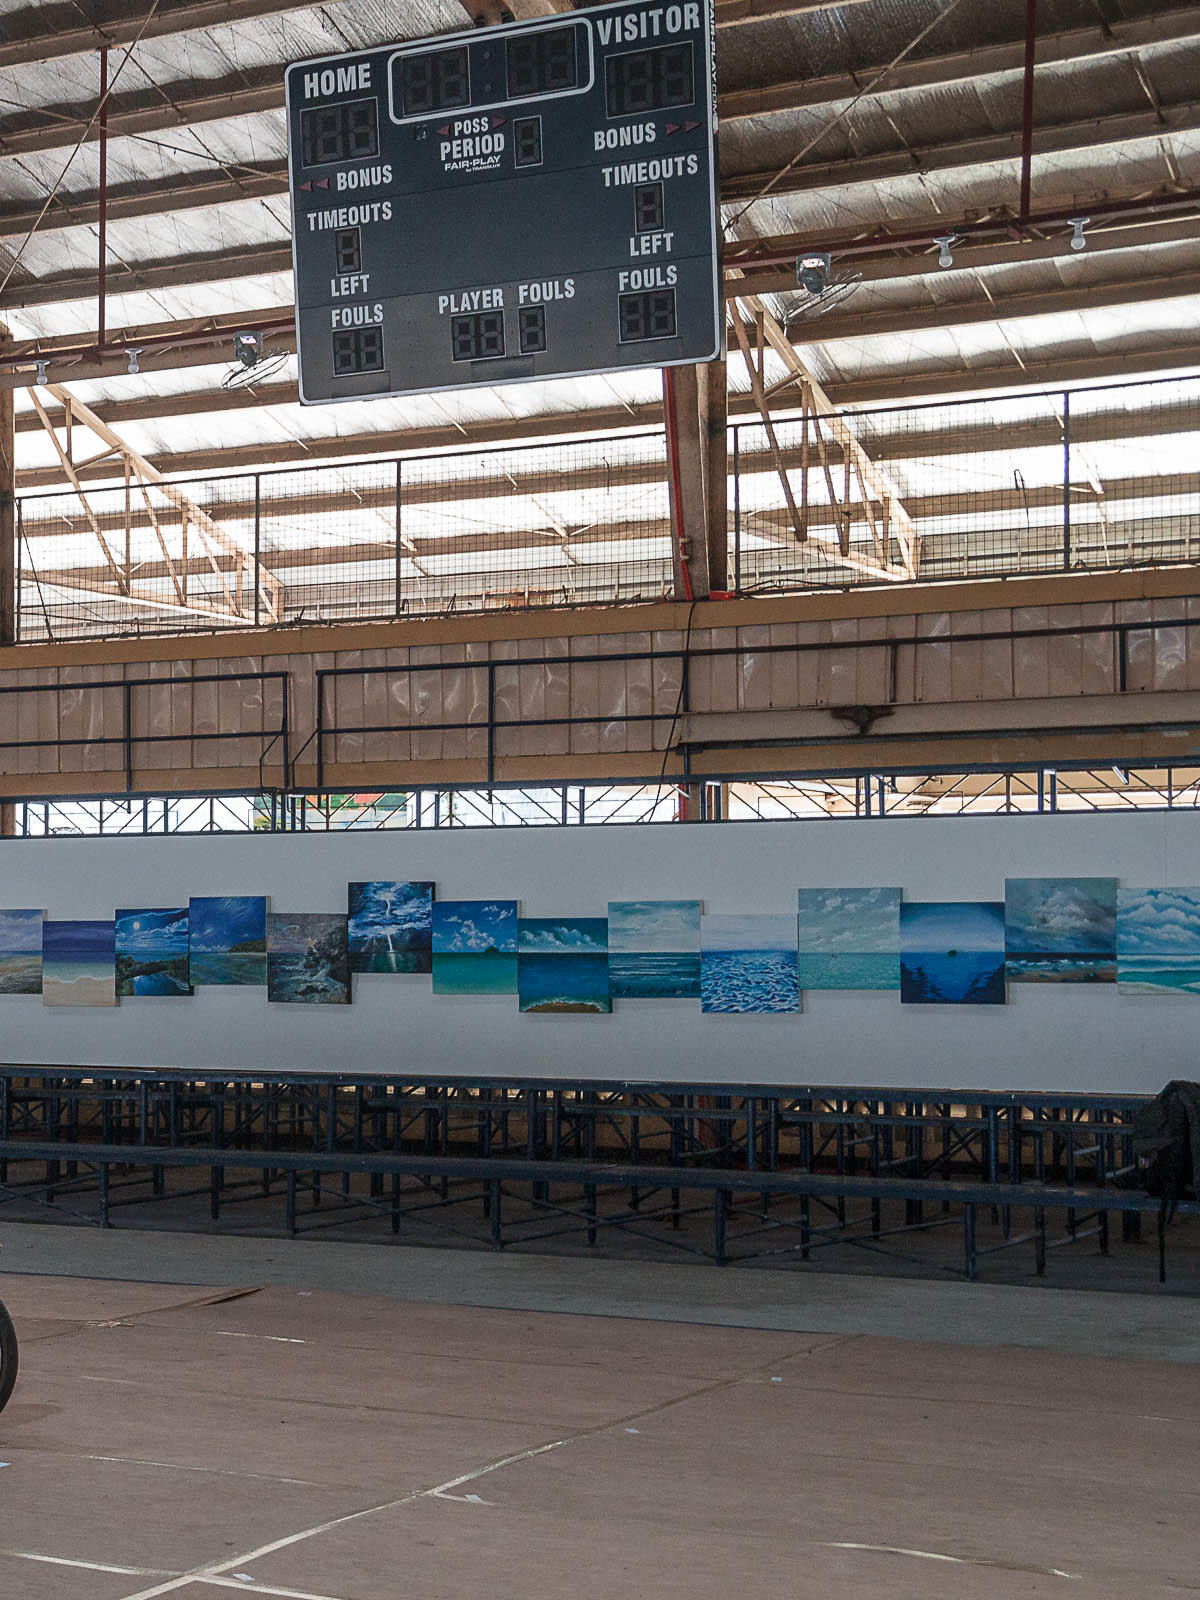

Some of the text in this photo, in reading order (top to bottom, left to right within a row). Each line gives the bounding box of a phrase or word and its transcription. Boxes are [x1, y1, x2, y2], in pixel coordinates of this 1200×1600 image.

[597, 2, 700, 46] VISITOR
[304, 63, 372, 99] HOME
[454, 117, 489, 136] POSS
[594, 123, 657, 151] BONUS
[440, 133, 505, 161] PERIOD
[337, 165, 393, 191] BONUS
[602, 154, 698, 187] TIMEOUTS
[307, 201, 393, 231] TIMEOUTS
[629, 233, 674, 257] LEFT
[331, 274, 370, 297] LEFT
[618, 265, 678, 291] FOULS
[438, 279, 575, 314] PLAYER FOULS
[331, 304, 384, 328] FOULS
